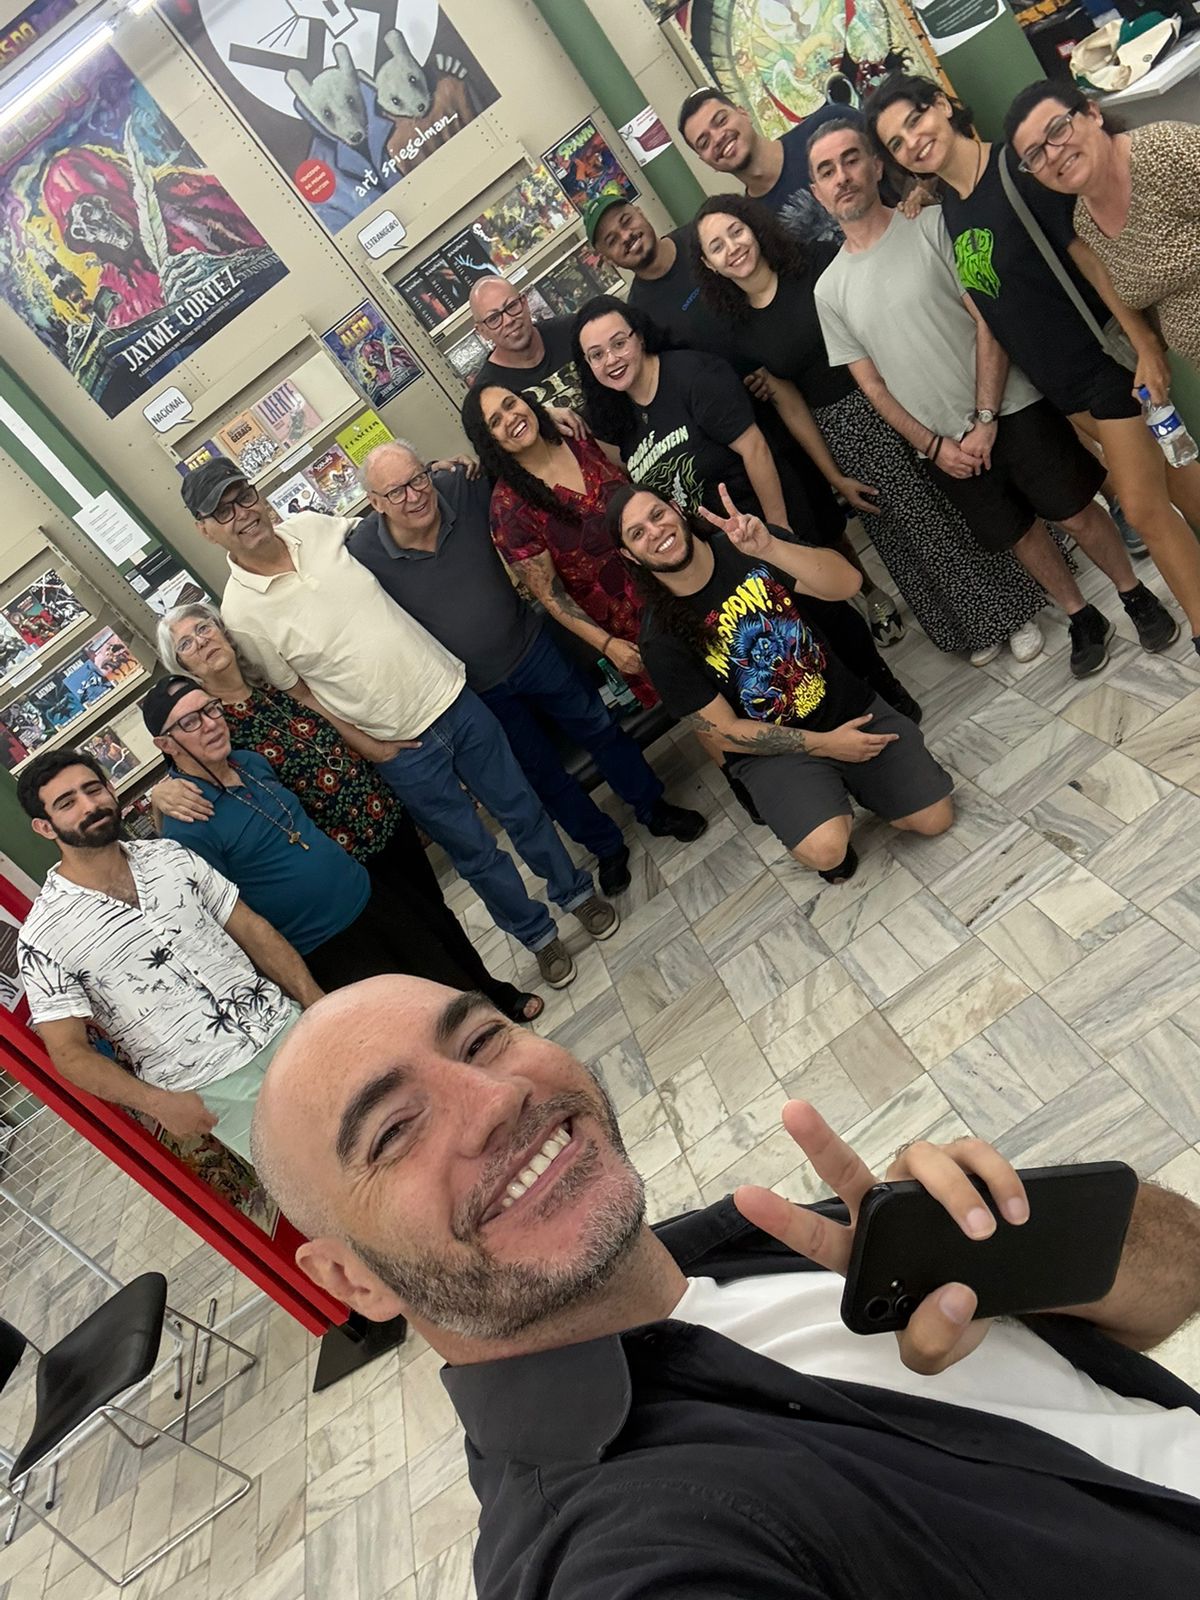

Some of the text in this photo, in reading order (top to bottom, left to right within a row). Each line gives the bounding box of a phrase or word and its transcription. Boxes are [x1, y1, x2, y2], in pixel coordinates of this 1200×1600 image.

[354, 113, 459, 198] art spiegelman
[557, 124, 595, 160] SPAWN
[364, 219, 399, 250] ESTRANGEIRO
[441, 293, 456, 311] GAIMA
[119, 265, 241, 372] JAYME CORTEZ
[421, 309, 436, 327] GAIMA
[151, 396, 185, 425] NACIONAL
[257, 382, 302, 425] LAERTE
[230, 424, 252, 442] GERAIS
[629, 424, 688, 484] FRANKENSTEIN
[62, 658, 84, 677] BATMAN
[35, 680, 56, 699] BATMAN
